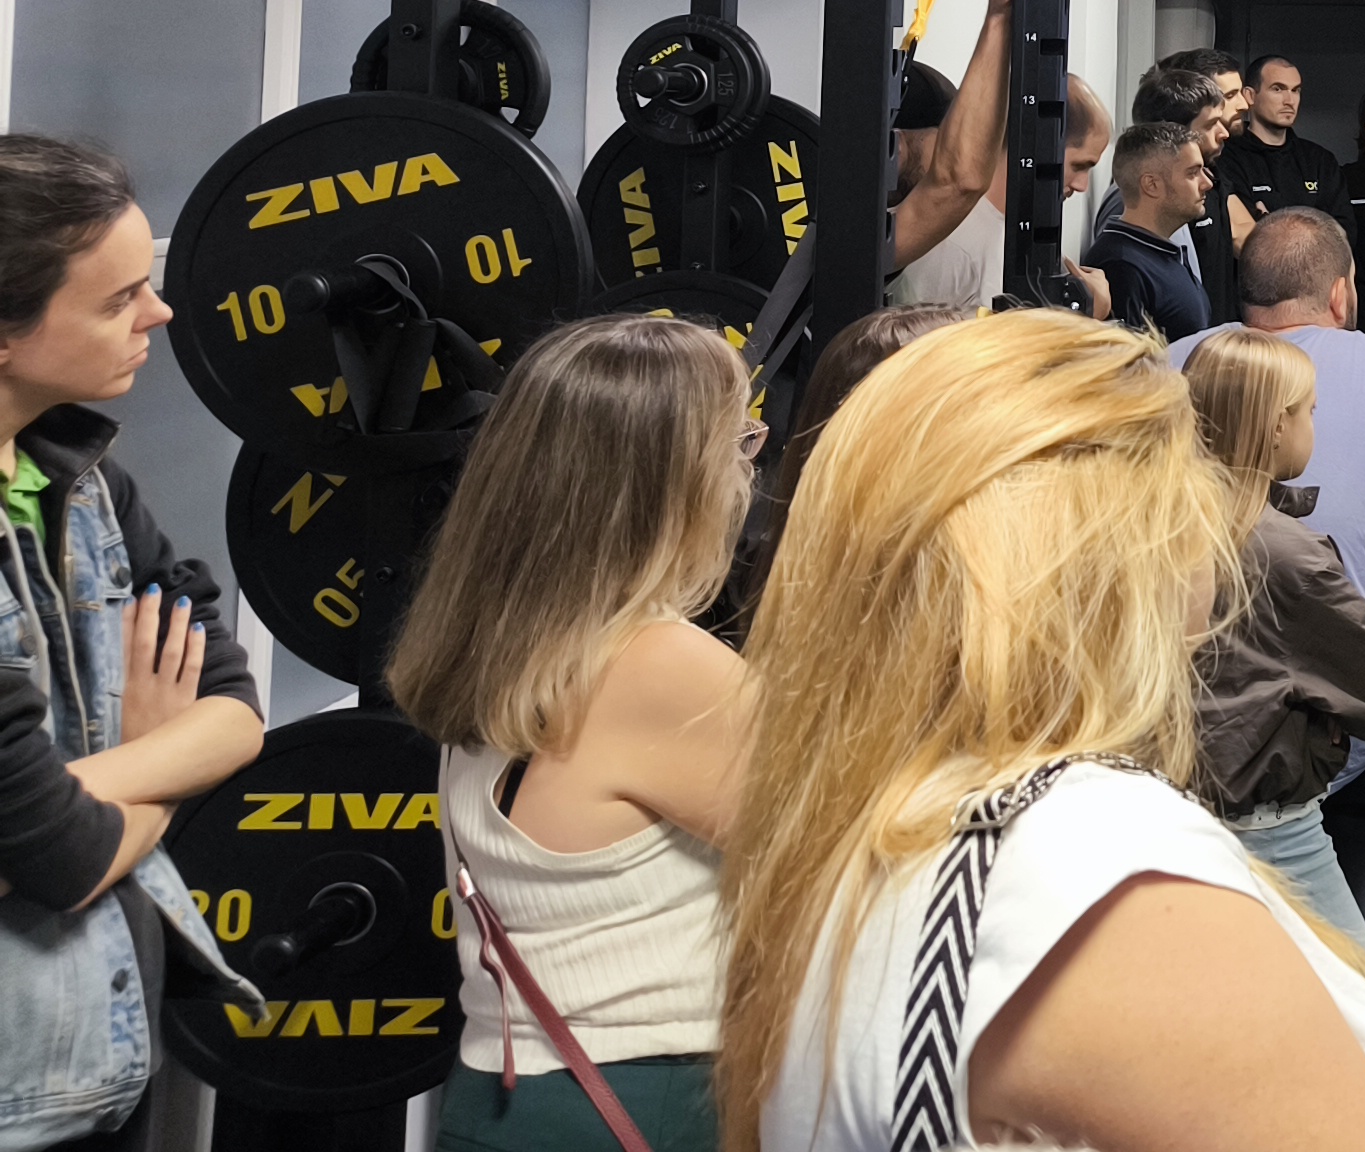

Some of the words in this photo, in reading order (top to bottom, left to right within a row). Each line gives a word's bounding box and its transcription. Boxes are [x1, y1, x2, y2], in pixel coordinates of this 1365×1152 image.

[650, 42, 683, 65] ZIVA
[1025, 32, 1037, 42] 14
[496, 61, 510, 100] ZIVA
[1022, 95, 1036, 105] 13
[1020, 158, 1033, 168] 12
[245, 152, 461, 230] ZIVA
[768, 140, 809, 256] ZIV
[619, 167, 663, 278] IVA
[1018, 221, 1031, 231] 11
[464, 227, 533, 284] 10
[216, 284, 287, 342] 10
[237, 792, 443, 831] ZIVA
[222, 998, 447, 1038] ZIVA
